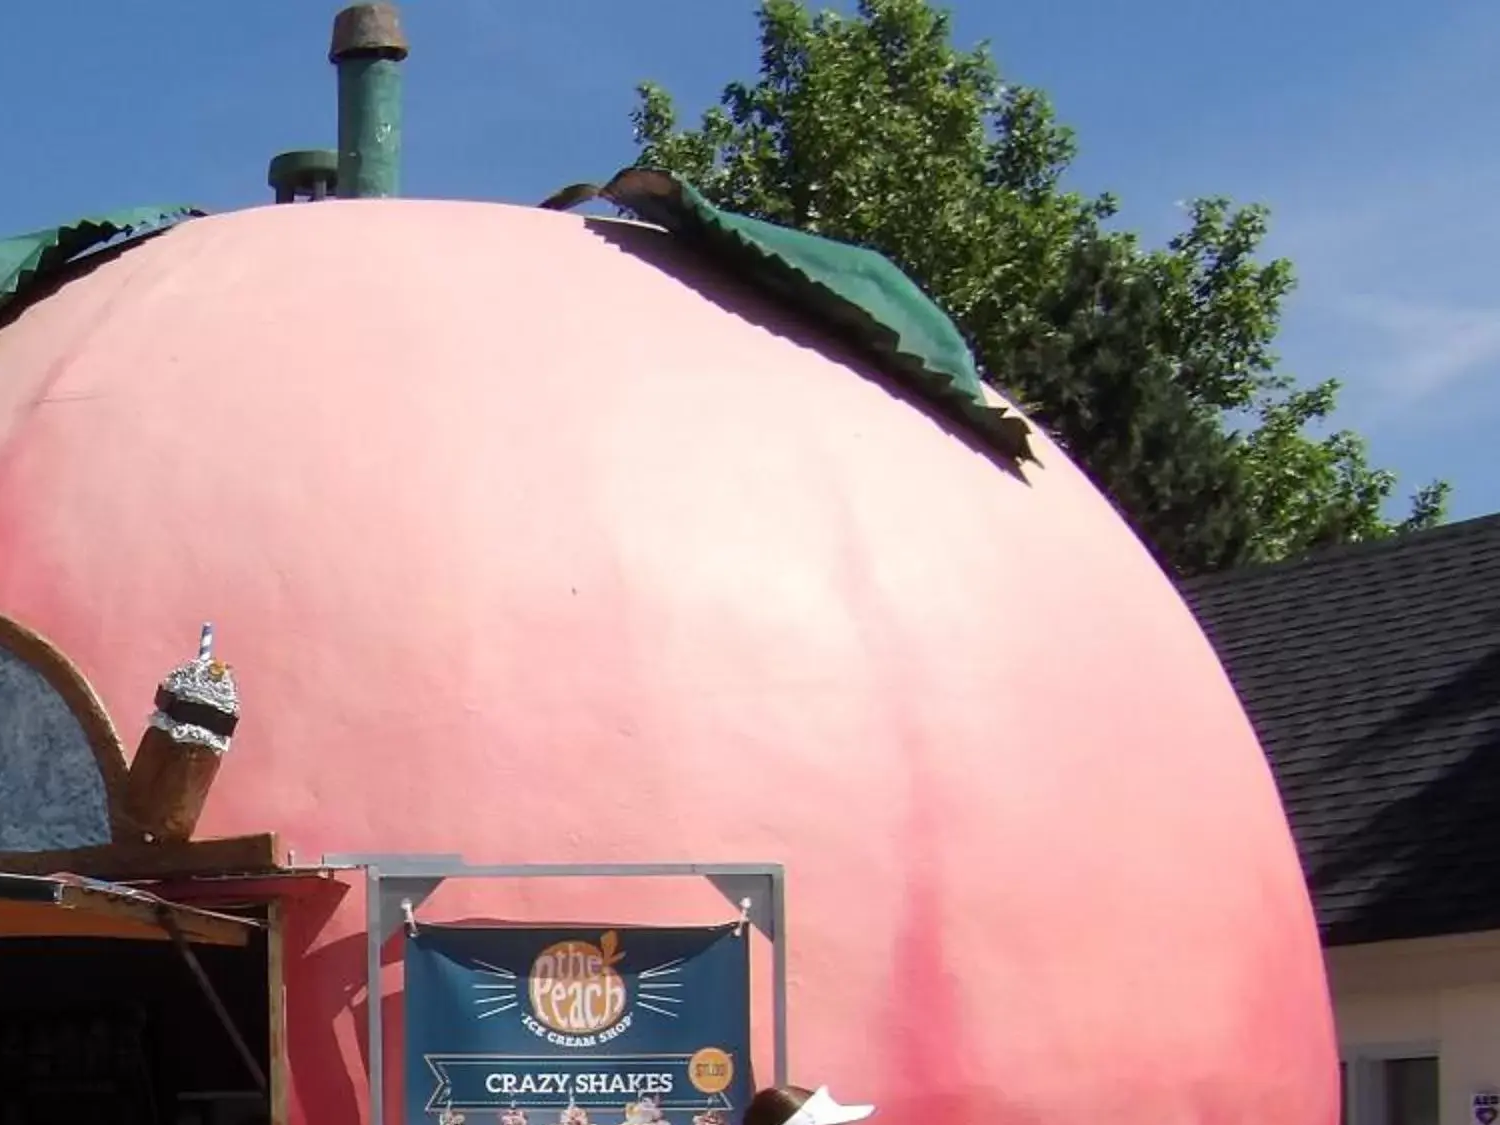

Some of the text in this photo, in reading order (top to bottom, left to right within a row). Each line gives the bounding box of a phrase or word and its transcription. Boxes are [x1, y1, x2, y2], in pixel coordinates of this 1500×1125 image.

[555, 945, 601, 980] the
[530, 956, 625, 1032] Peach
[521, 1013, 633, 1048] ICE CREAM SHOP
[485, 1073, 673, 1094] CRAZY SHAKES
